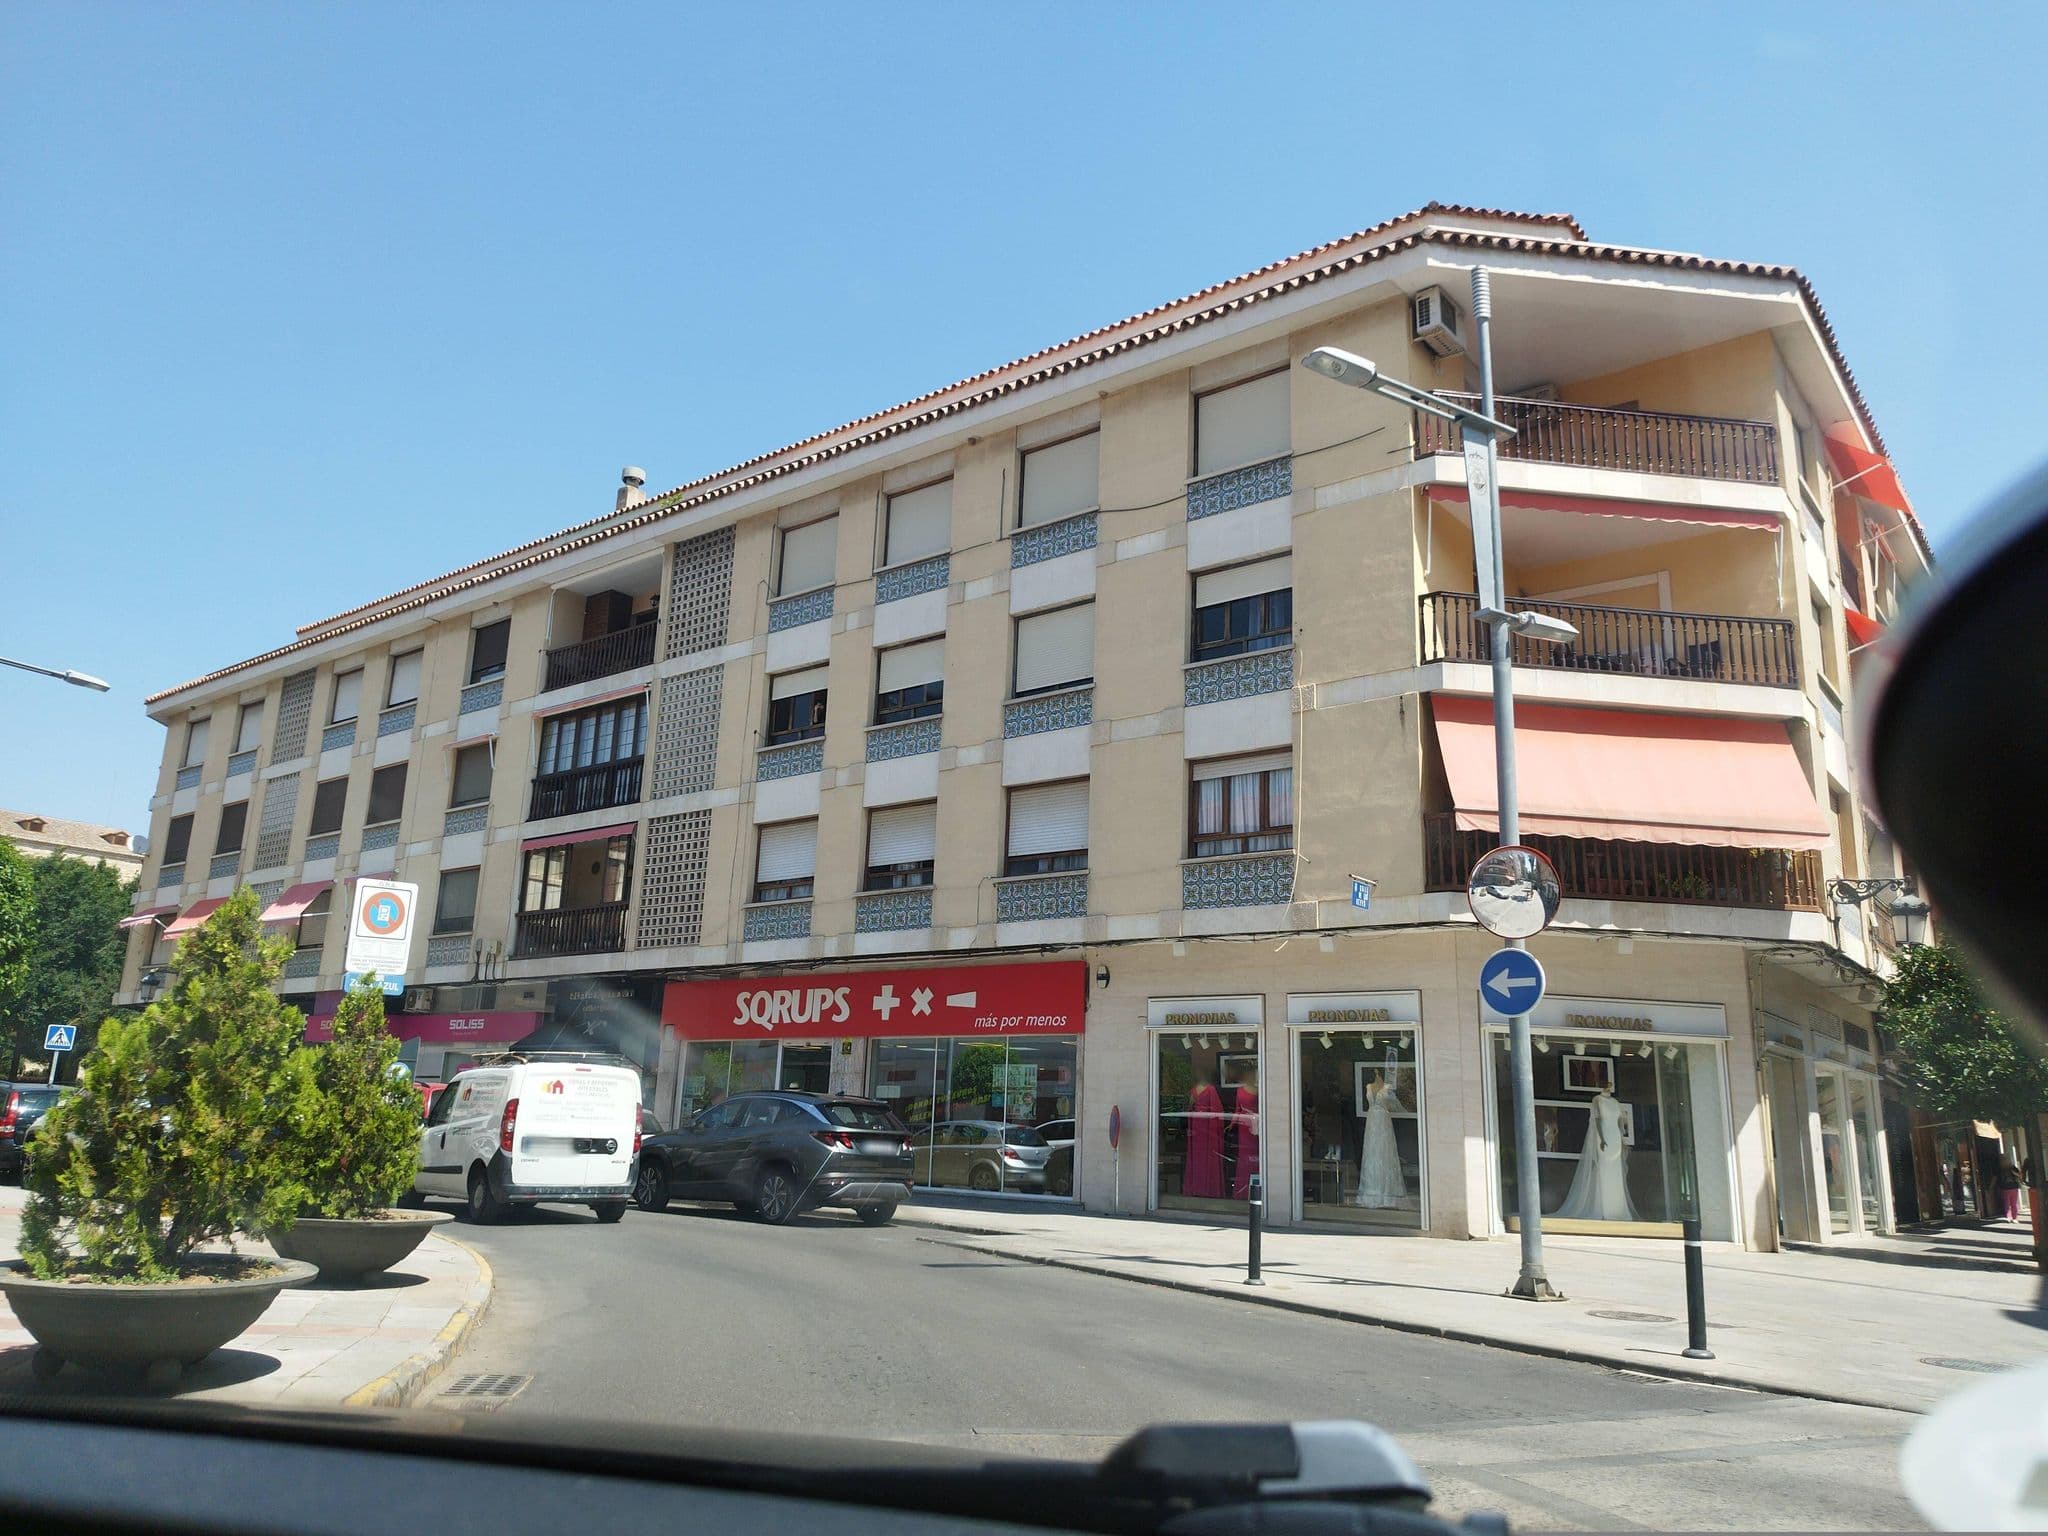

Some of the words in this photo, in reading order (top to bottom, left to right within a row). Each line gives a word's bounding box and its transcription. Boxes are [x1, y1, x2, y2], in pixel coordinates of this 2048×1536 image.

[733, 986, 851, 1031] SQRUPS
[1308, 1008, 1390, 1022] PRONOVIAS
[449, 1018, 485, 1030] SOLISS
[974, 1013, 998, 1027] más
[1000, 1016, 1023, 1031] por
[1025, 1015, 1066, 1027] menos
[1165, 1012, 1237, 1024] PRONOVIAS
[1565, 1014, 1654, 1031] PRONOVIAS
